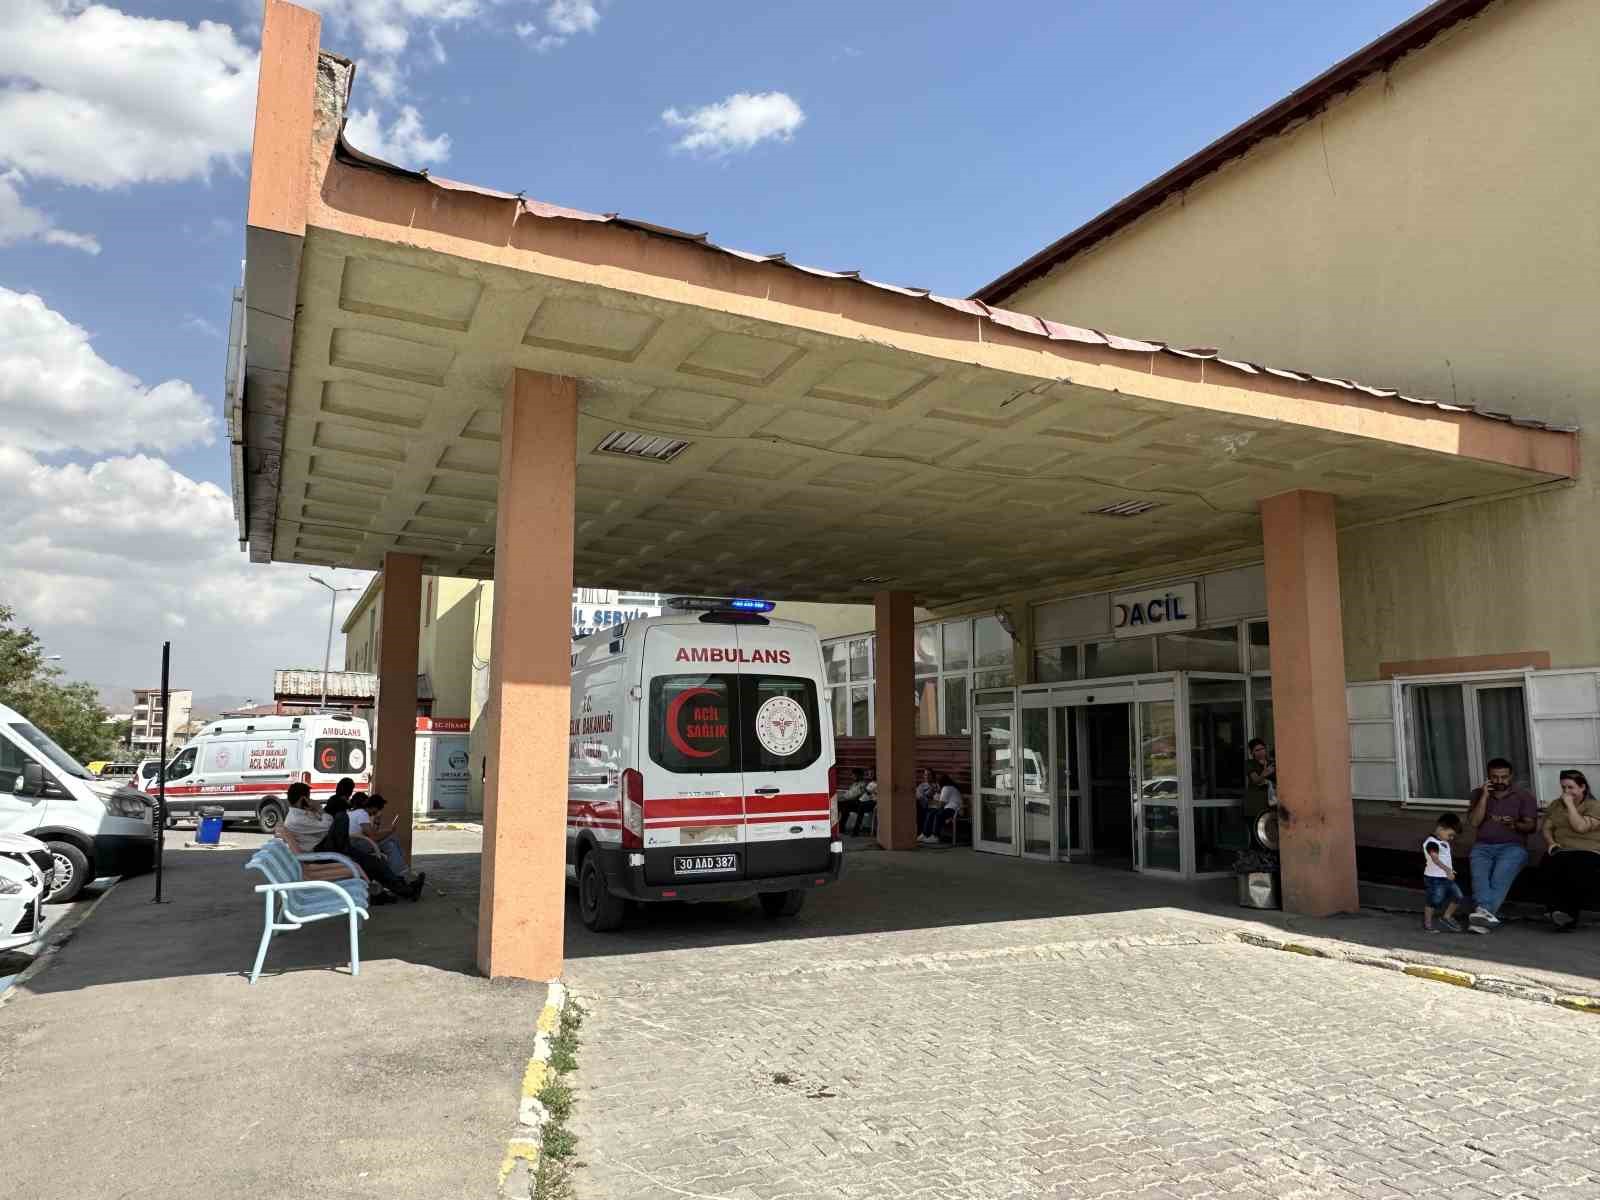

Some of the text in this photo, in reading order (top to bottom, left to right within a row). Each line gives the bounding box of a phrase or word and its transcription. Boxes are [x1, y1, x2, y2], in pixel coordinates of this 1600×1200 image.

[1129, 592, 1187, 625] ACİL
[675, 647, 791, 664] AMBULANS
[693, 706, 719, 721] ACİL
[582, 711, 614, 735] BAKANLIĞI
[687, 722, 729, 738] SAĞLIK
[322, 727, 362, 737] AMBULANS
[263, 757, 286, 769] SAĞLIK
[200, 784, 236, 793] AMBULANS
[679, 856, 734, 870] 30 AAD 387
